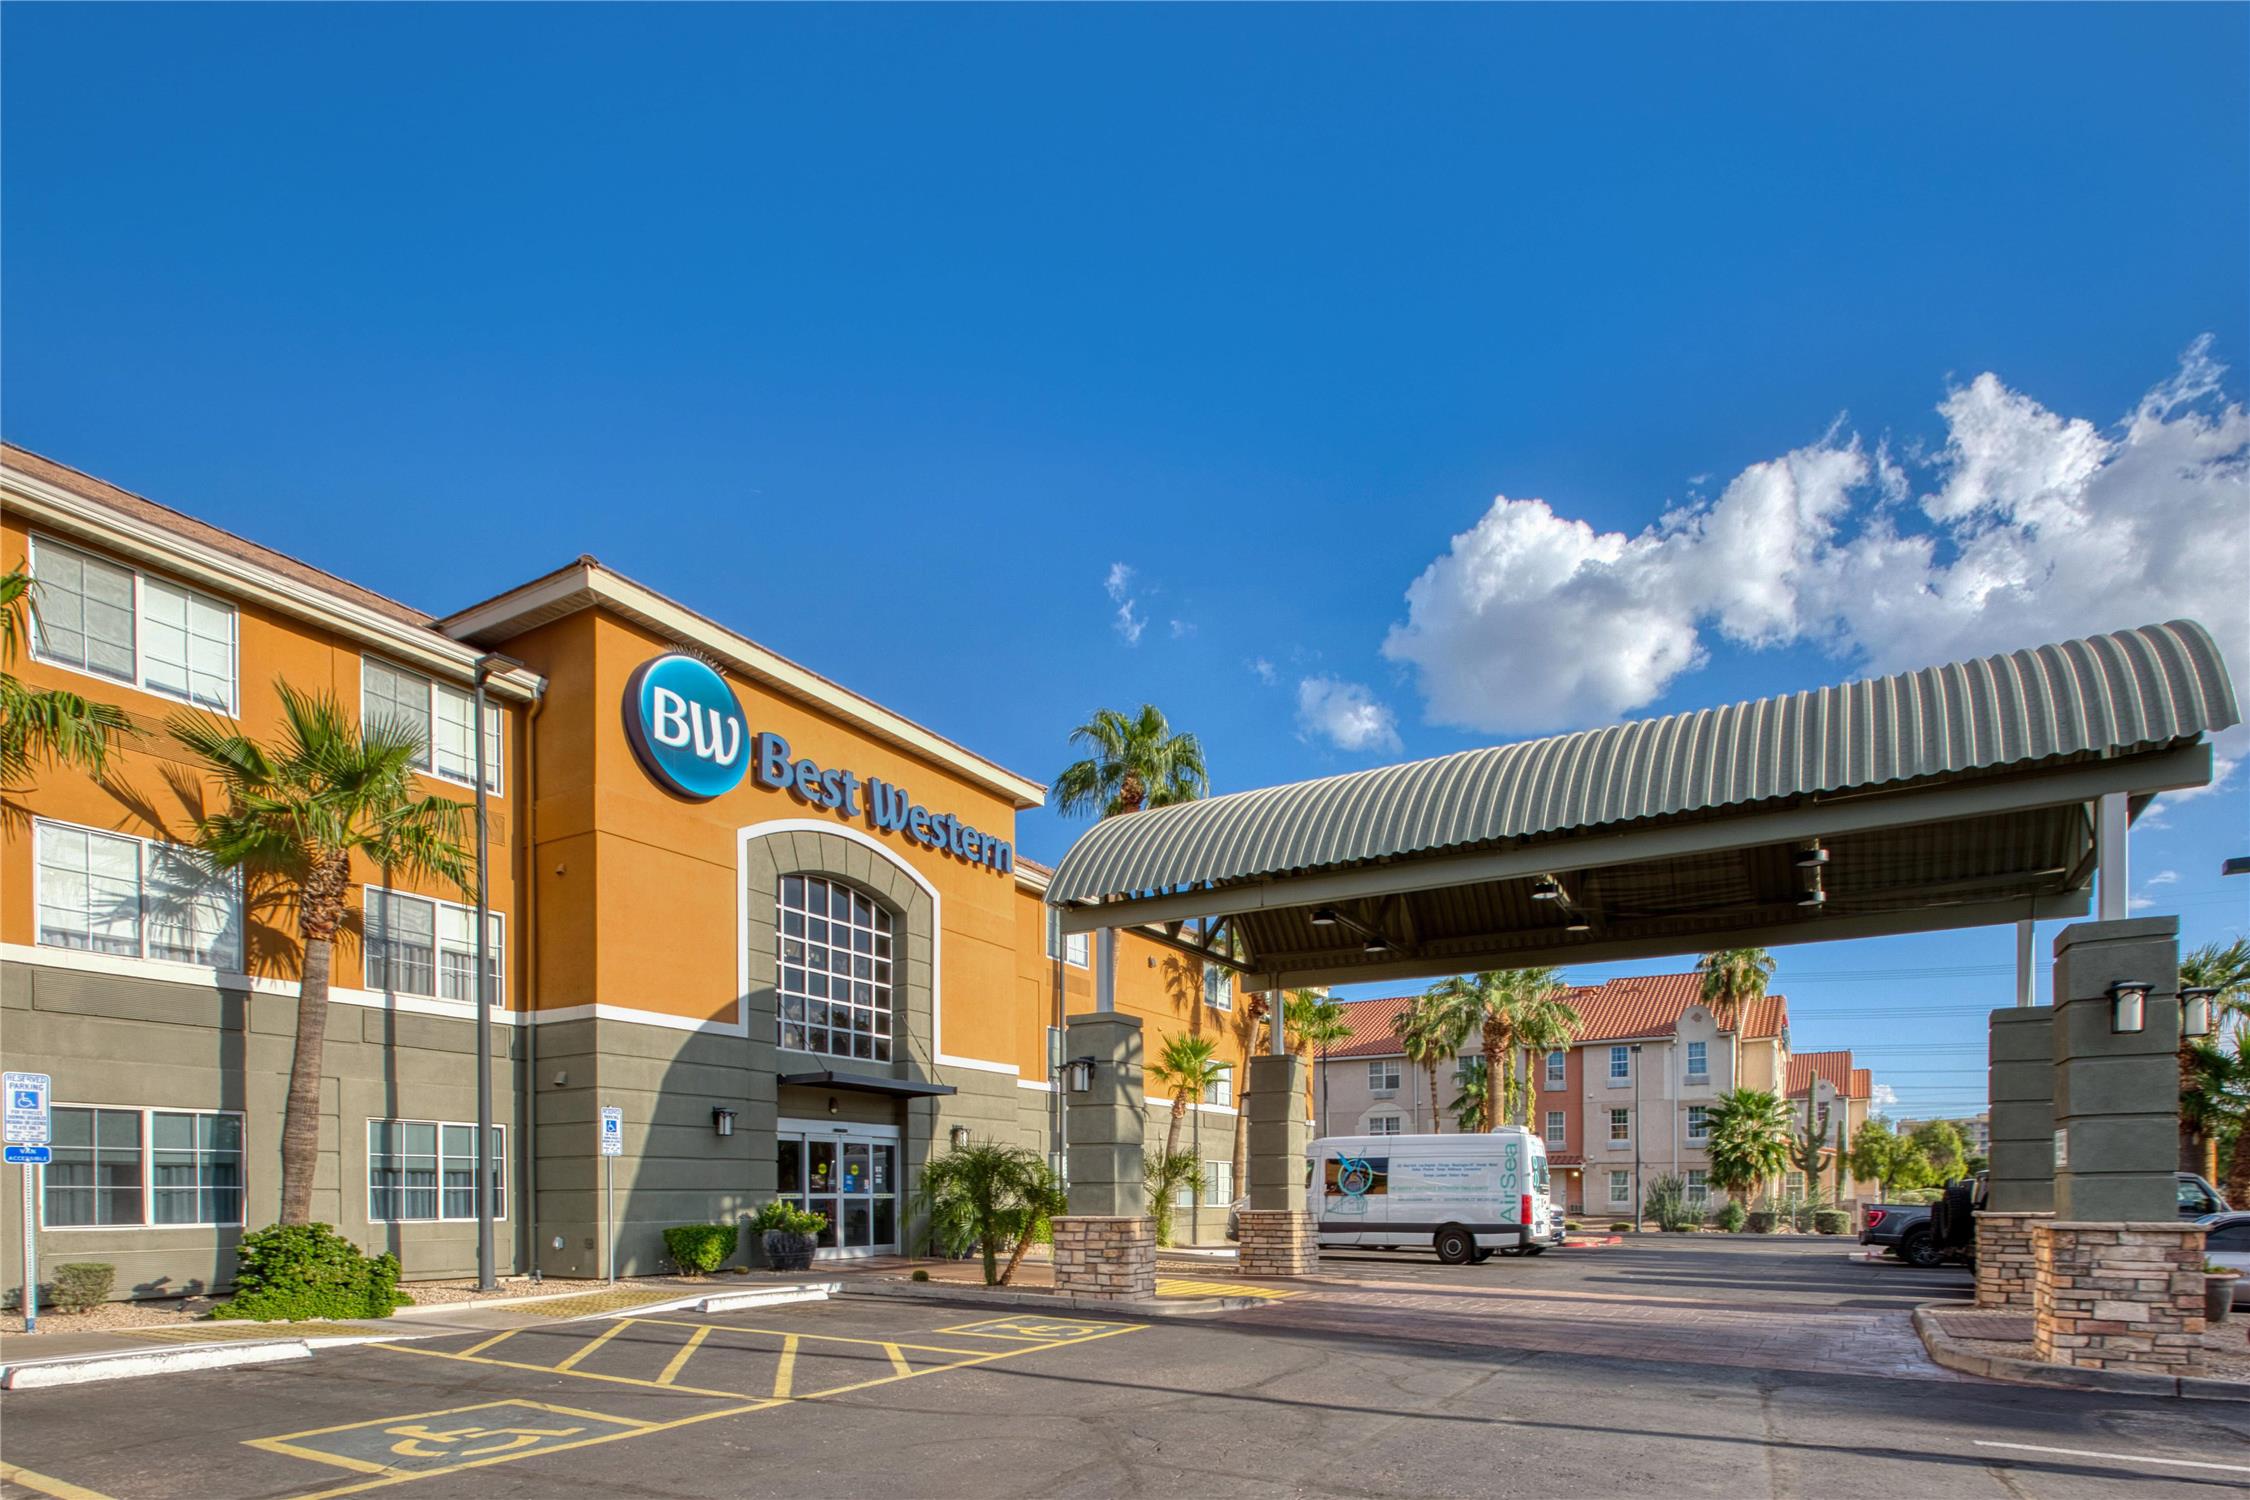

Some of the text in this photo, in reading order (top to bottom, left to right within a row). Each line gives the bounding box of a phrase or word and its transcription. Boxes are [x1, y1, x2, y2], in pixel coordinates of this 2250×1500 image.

[653, 686, 740, 766] BW
[756, 731, 1013, 874] Best Western
[7, 1074, 47, 1084] RESERVED
[9, 1082, 44, 1091] PARKING
[1500, 1143, 1518, 1223] AirSea
